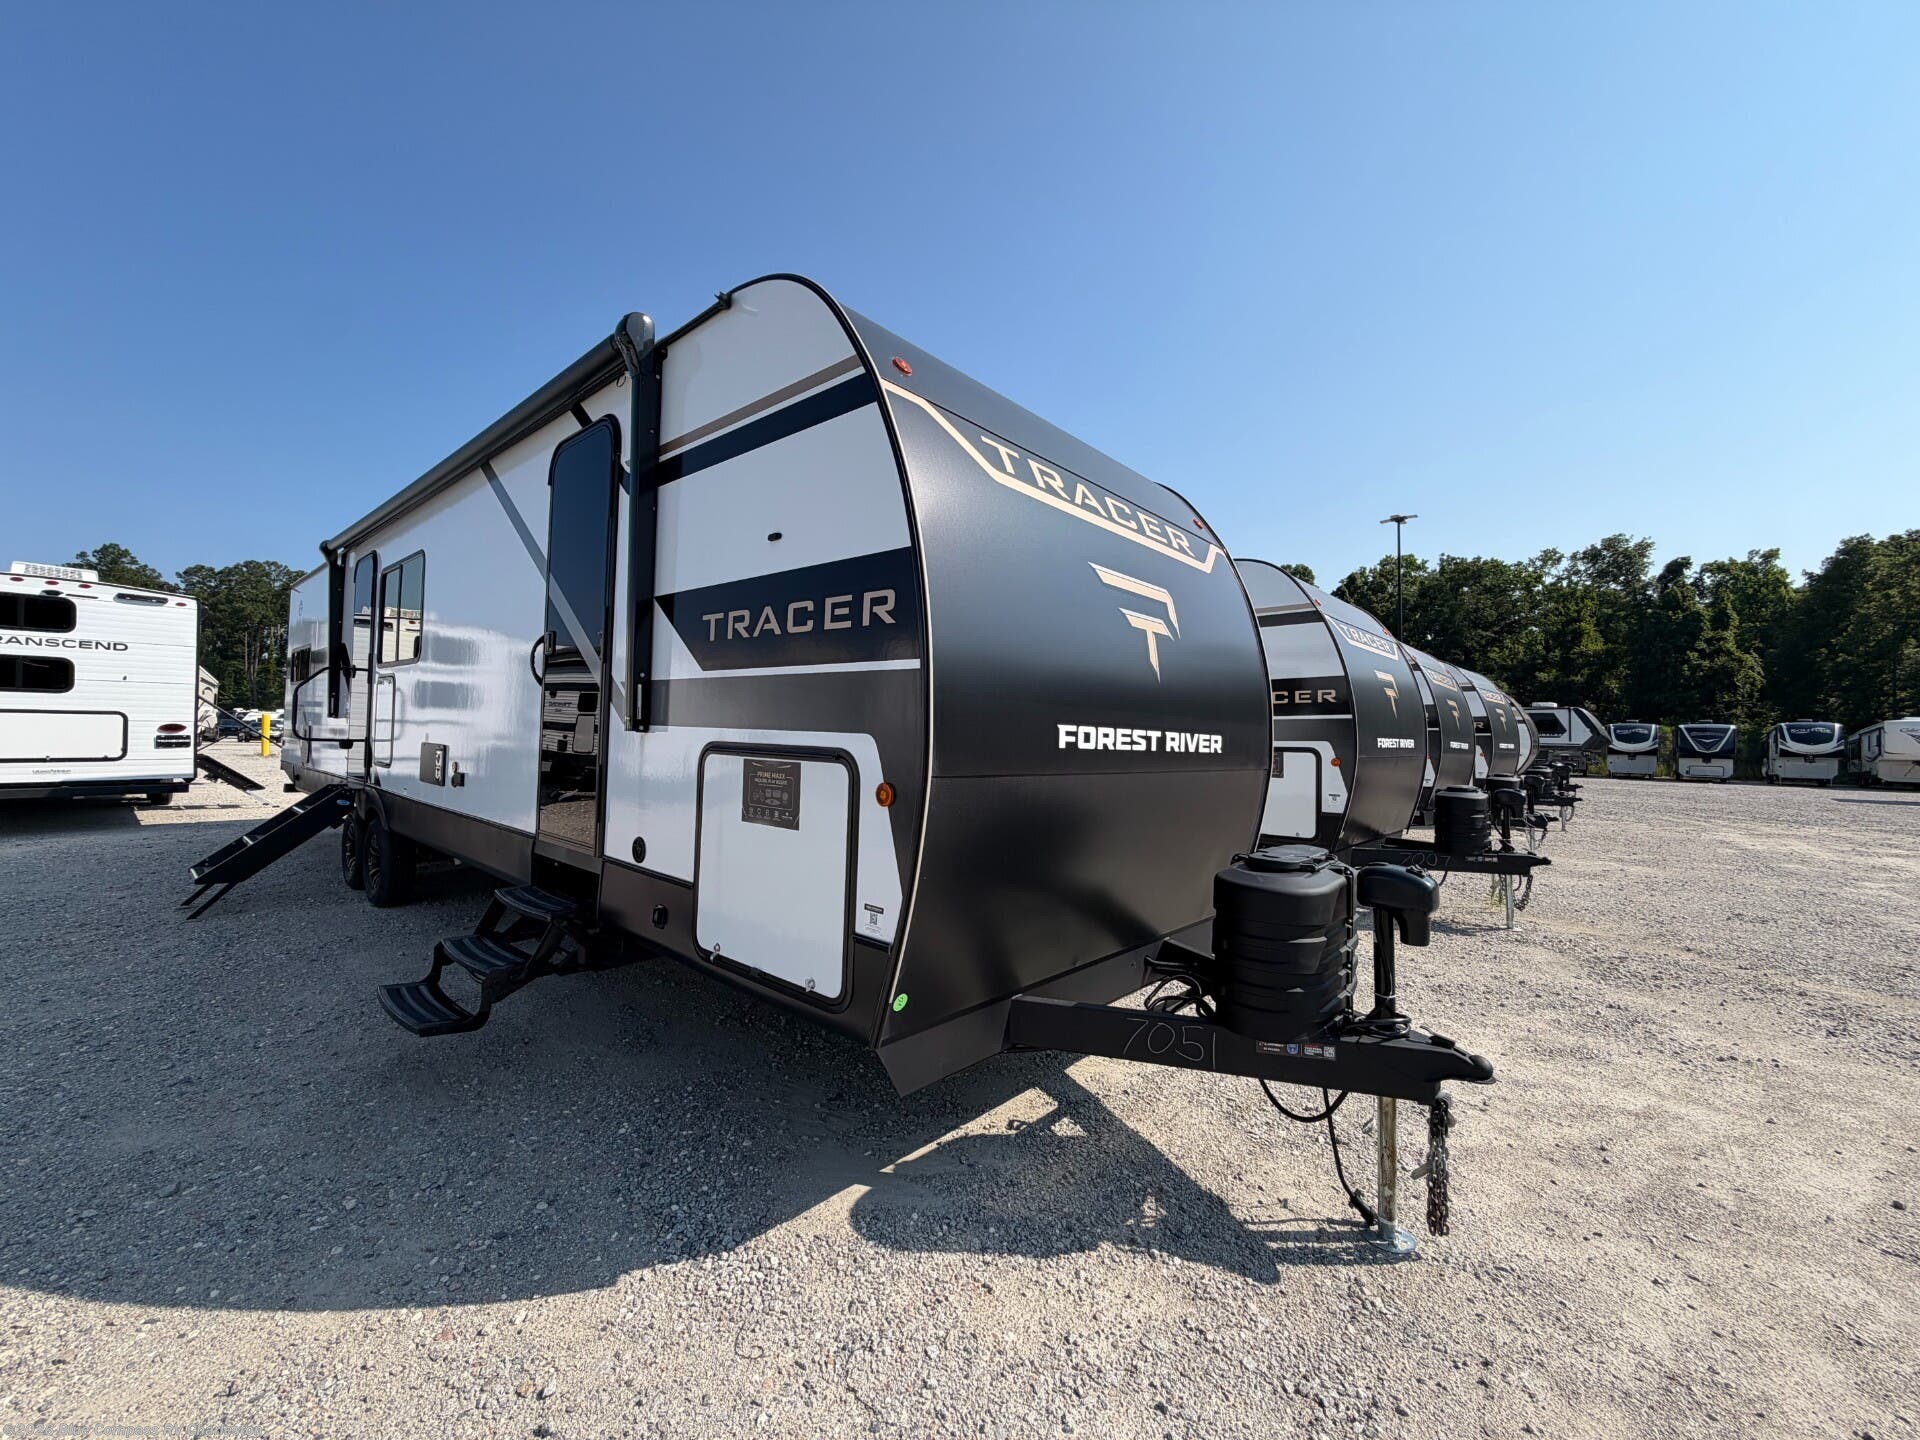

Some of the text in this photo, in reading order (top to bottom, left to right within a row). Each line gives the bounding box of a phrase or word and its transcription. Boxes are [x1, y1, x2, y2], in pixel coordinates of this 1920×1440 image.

[981, 436, 1195, 558] TRACER
[702, 588, 896, 642] TRACER
[0, 636, 128, 651] ANSCEND
[1340, 624, 1393, 653] TRACER
[1057, 723, 1223, 754] FOREST RIVER
[1377, 737, 1415, 749] FOREST RIVER
[1123, 1017, 1216, 1070] 7051
